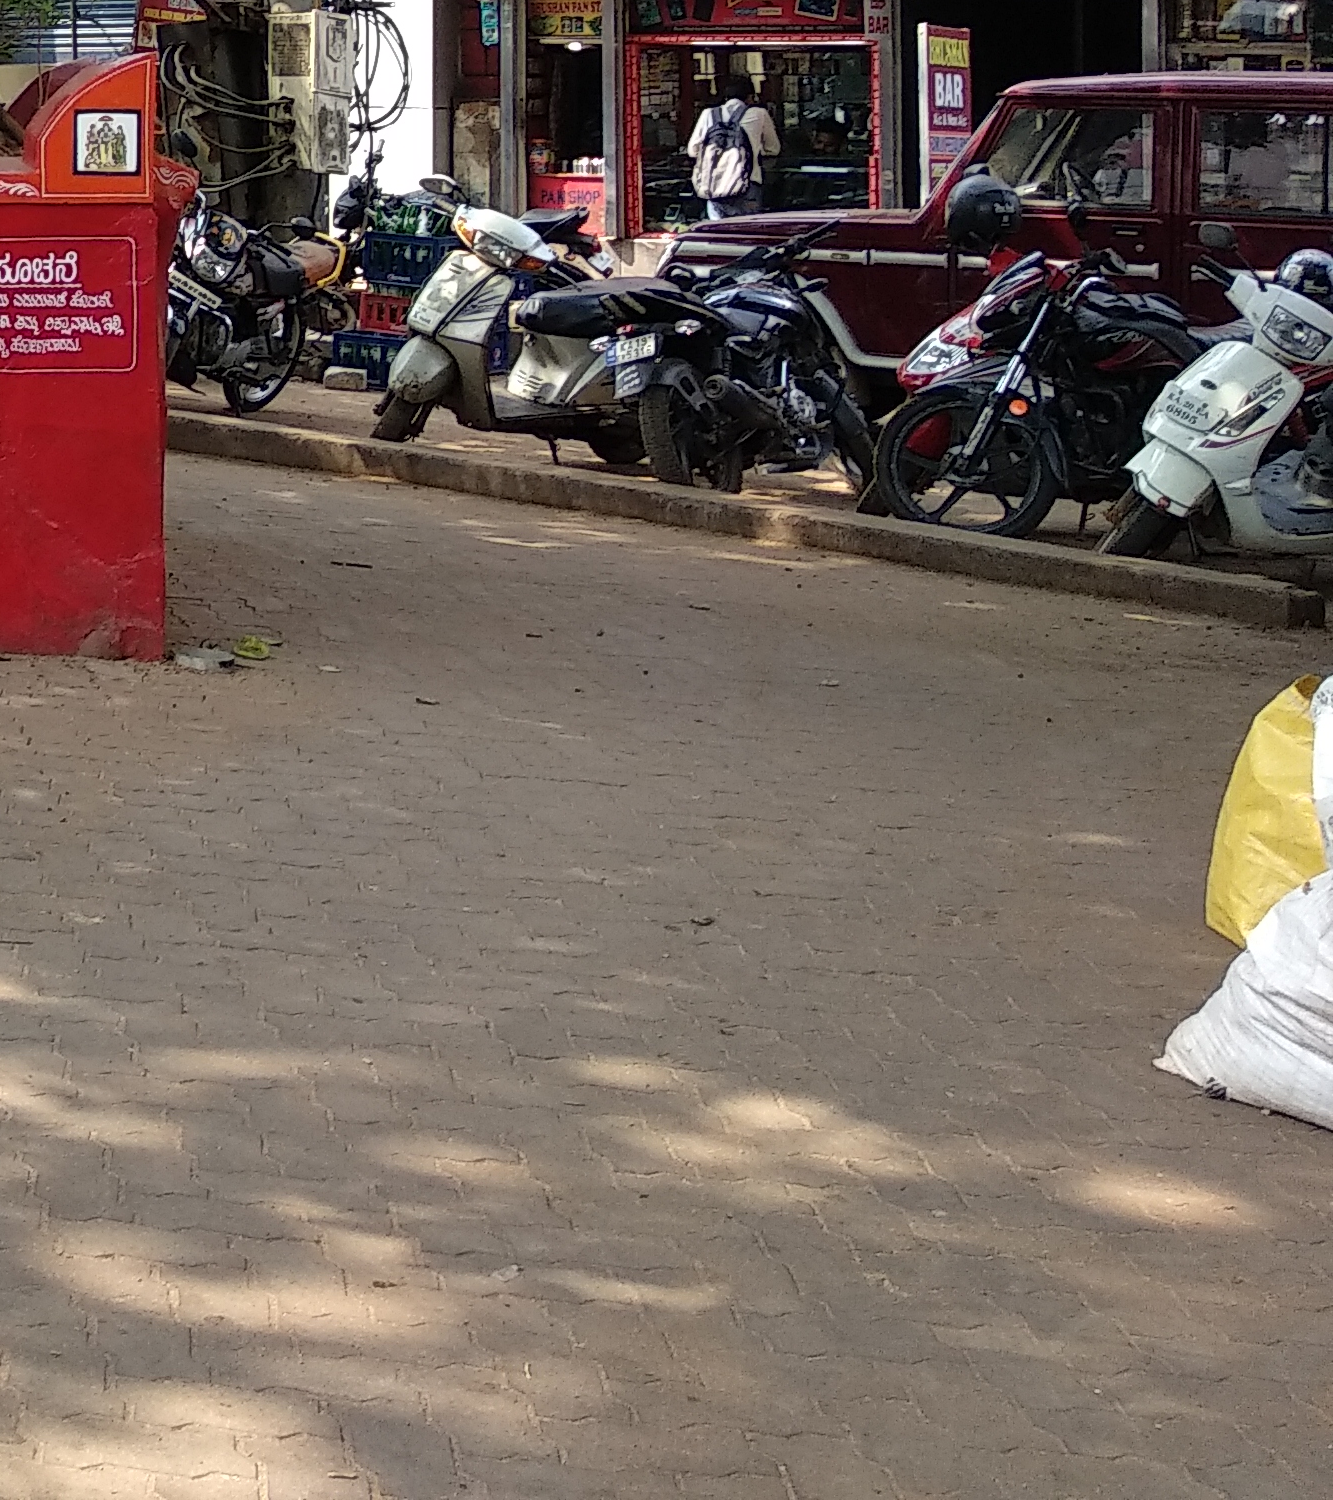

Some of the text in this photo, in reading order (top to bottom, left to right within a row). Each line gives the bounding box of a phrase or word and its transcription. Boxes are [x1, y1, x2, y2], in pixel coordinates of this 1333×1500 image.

[868, 16, 889, 34] BAR
[934, 72, 964, 109] BAR
[541, 189, 602, 204] PAN SHOP
